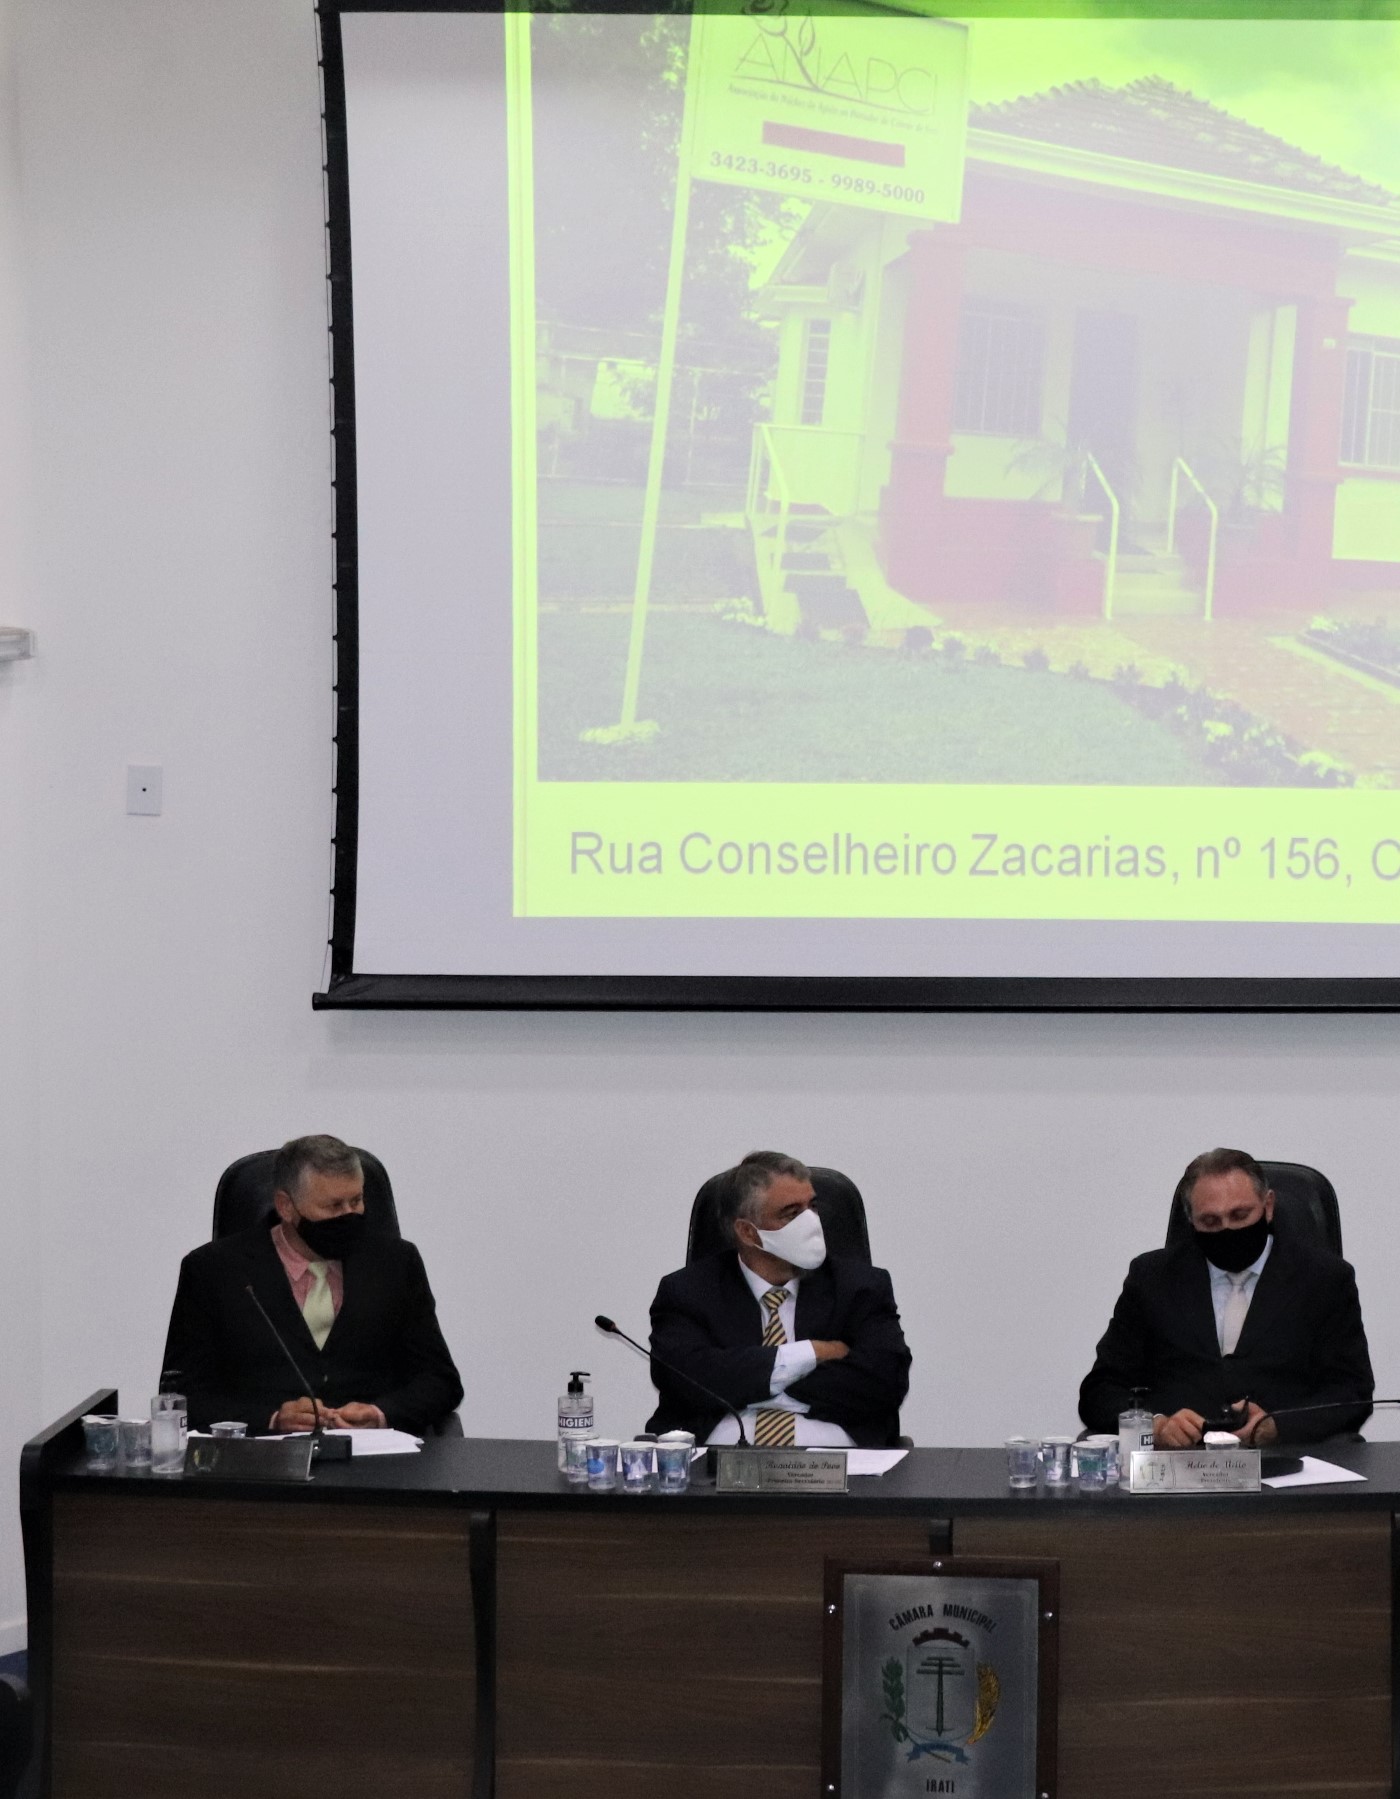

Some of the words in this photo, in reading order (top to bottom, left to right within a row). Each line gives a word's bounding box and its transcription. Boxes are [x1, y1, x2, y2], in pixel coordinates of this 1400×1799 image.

[710, 150, 813, 185] 3423-3695
[831, 173, 926, 205] 9989-5000
[571, 831, 663, 875] Rua
[679, 831, 957, 876] Conselheiro
[968, 833, 1180, 884] Zacarias,
[1196, 836, 1241, 878] nº
[1260, 837, 1353, 887] 156,
[943, 1604, 998, 1634] MUNICIPAL
[926, 1779, 955, 1793] IRATI
